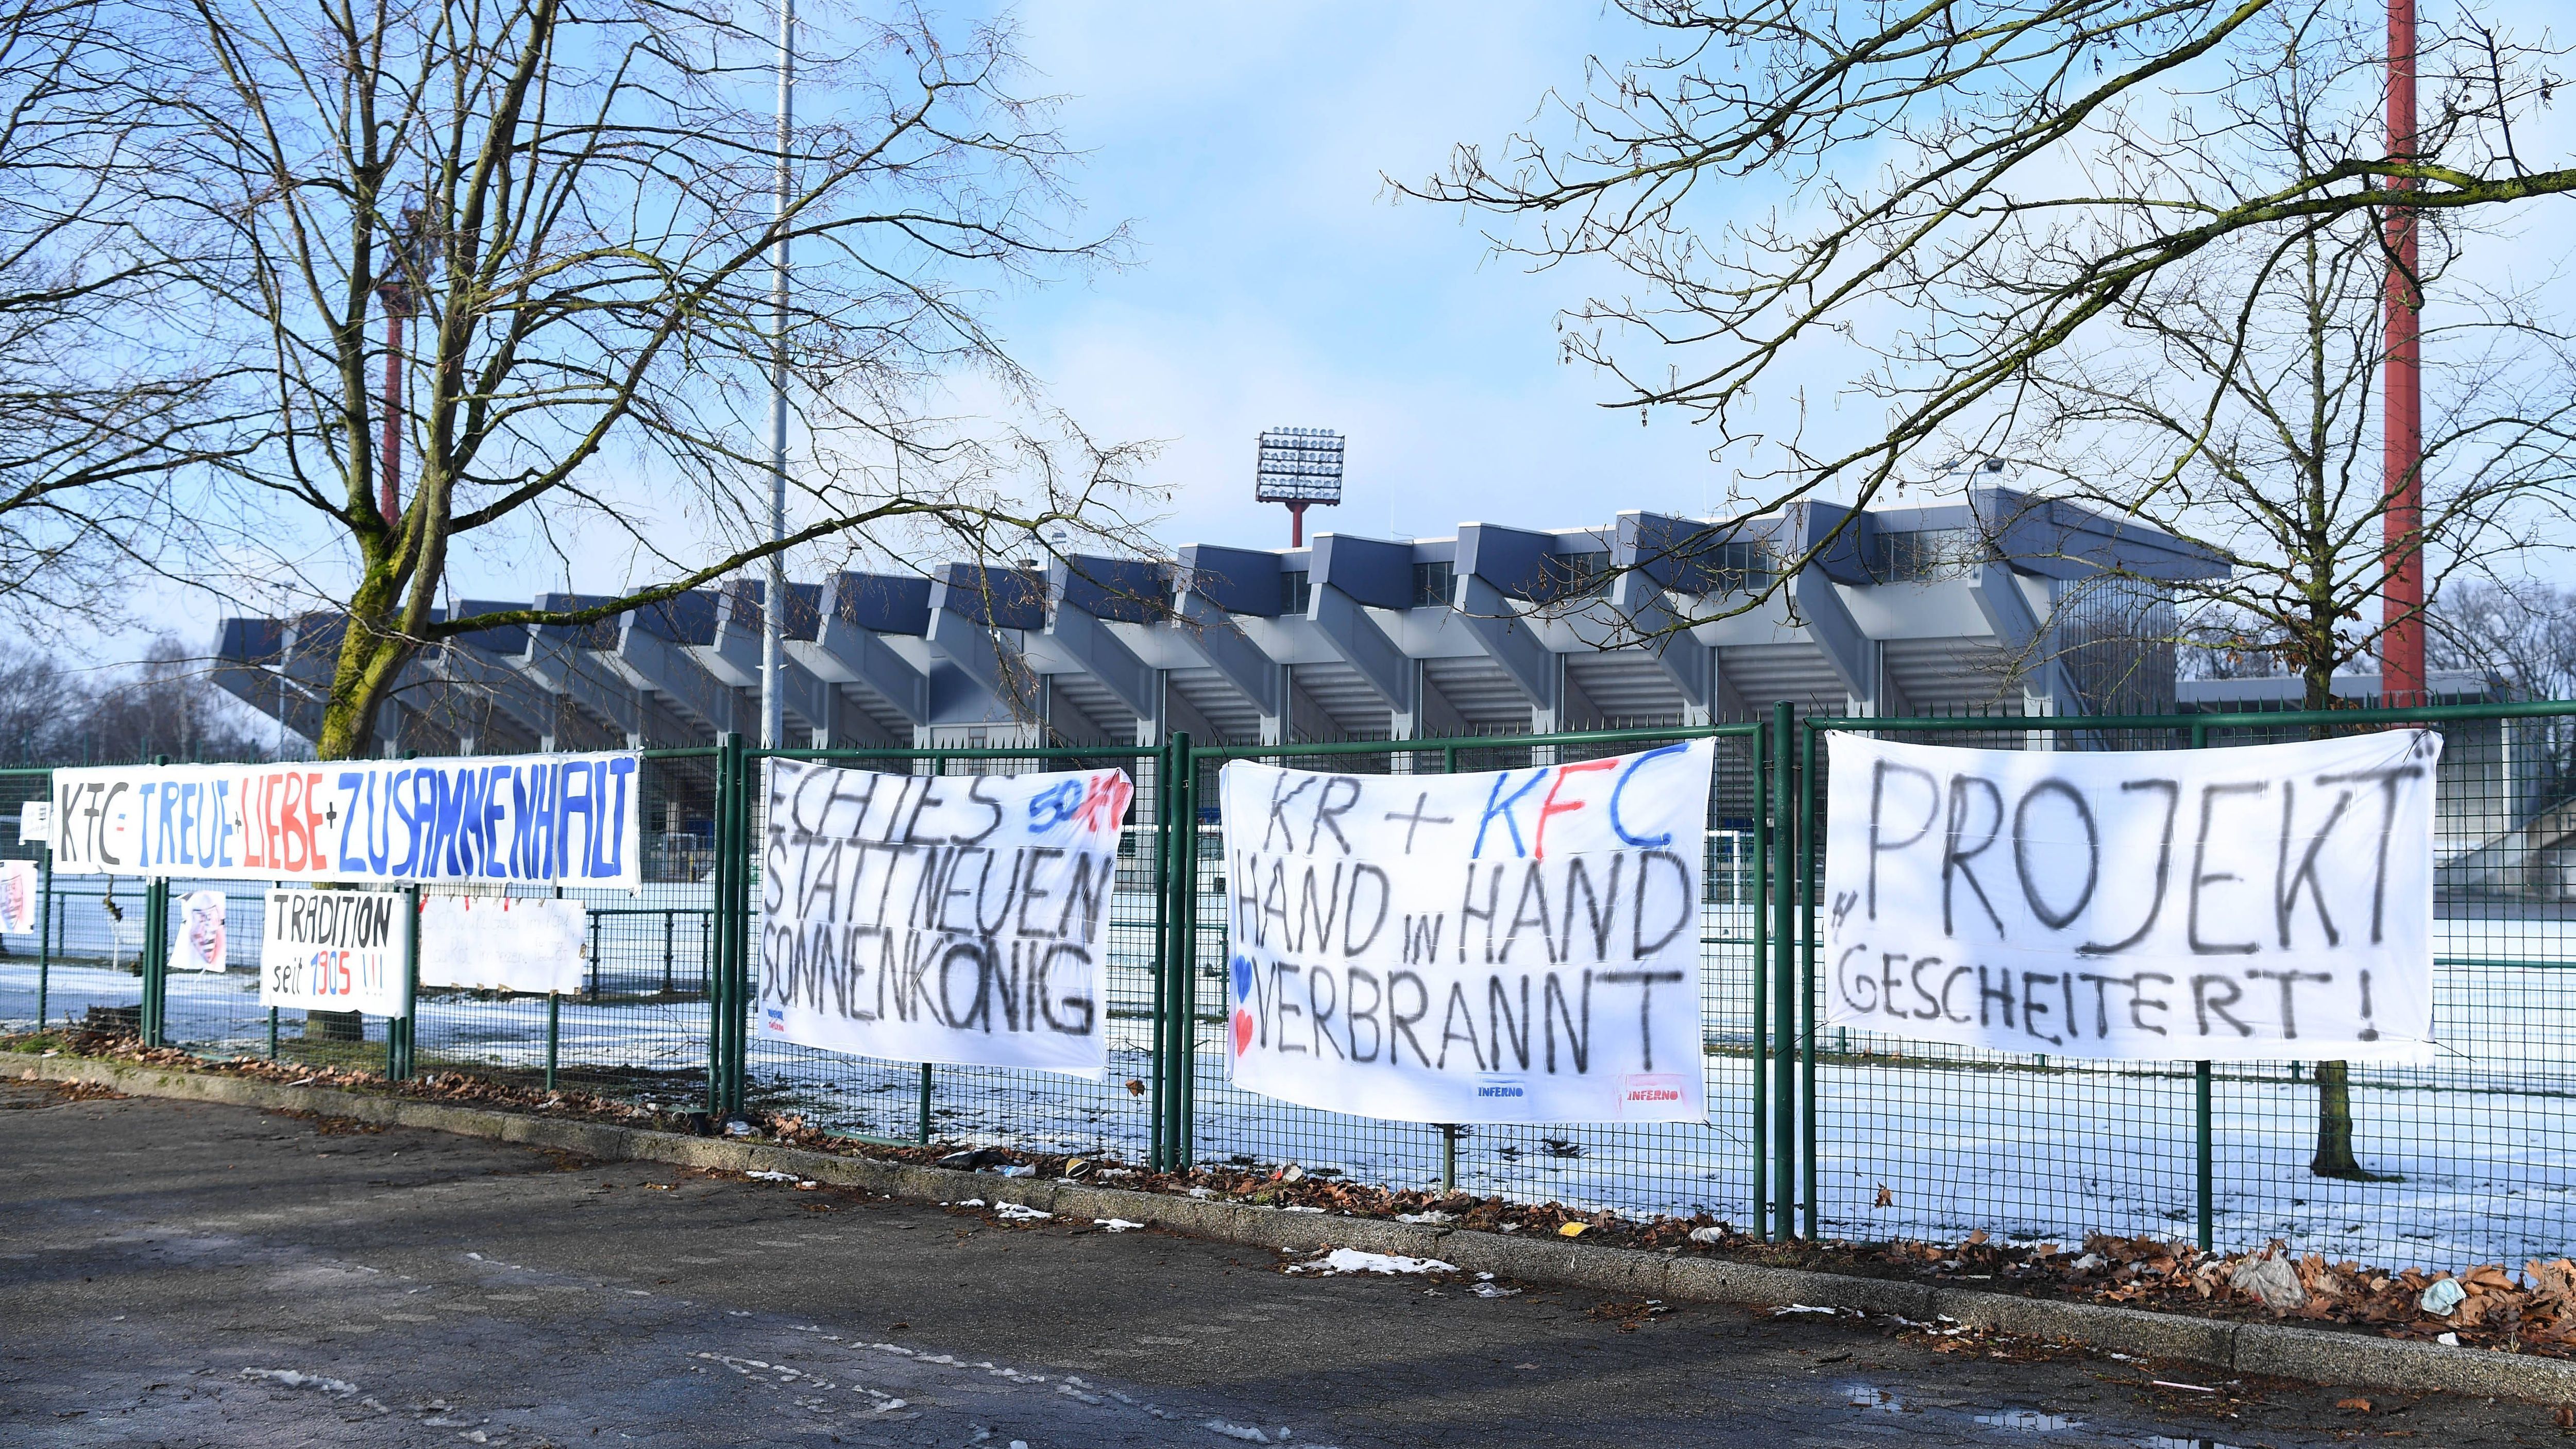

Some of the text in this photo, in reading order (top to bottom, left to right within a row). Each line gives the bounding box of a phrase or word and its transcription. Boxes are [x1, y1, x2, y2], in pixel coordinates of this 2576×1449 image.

[1263, 742, 1691, 863] KR + KFC
[274, 895, 393, 948] TRADITION
[764, 833, 1113, 944] STATT NEUEN
[1236, 849, 1694, 964] HAND IN HAND
[273, 957, 302, 995] seit
[311, 950, 350, 995] 1905
[762, 920, 1094, 1034] SONNENKÖNIG
[1251, 955, 1685, 1075] VERBRANNT
[1478, 1086, 1523, 1098] INFERNO
[1626, 1089, 1679, 1101] INFERNO
